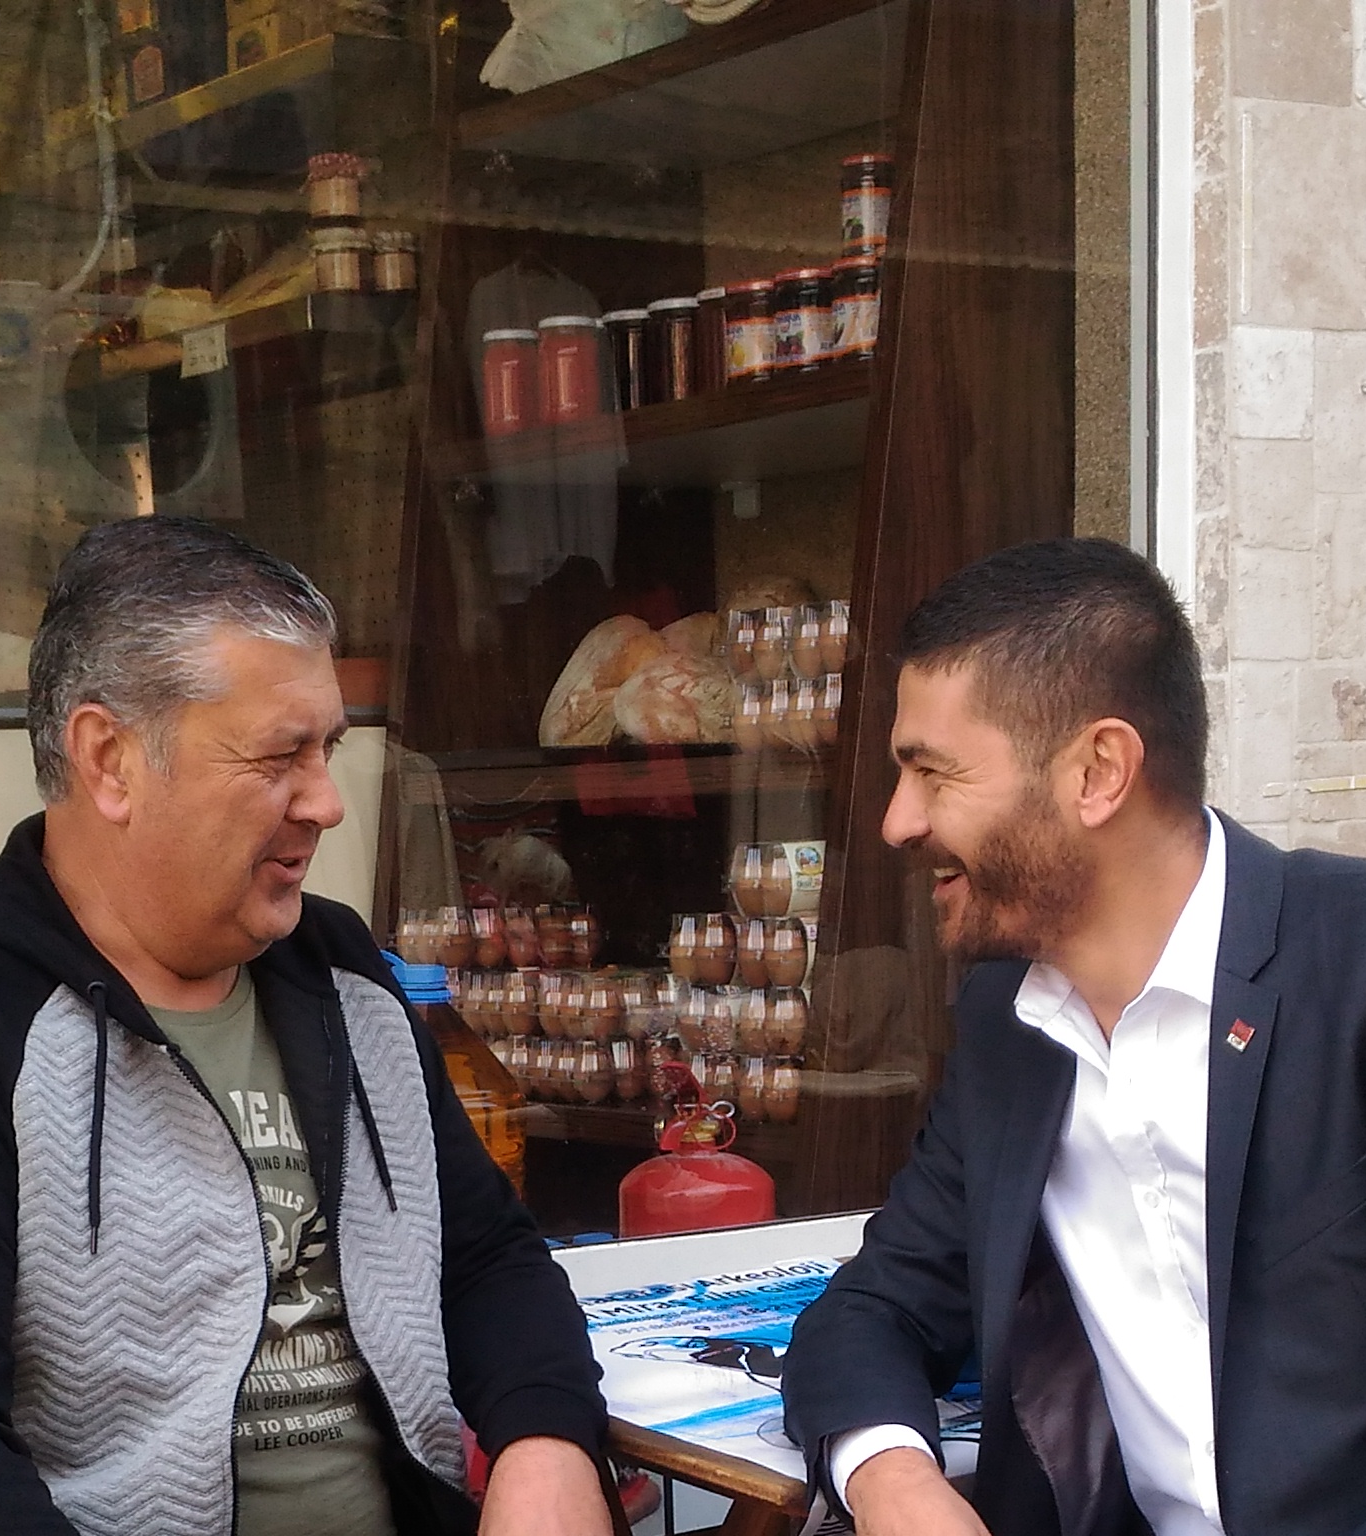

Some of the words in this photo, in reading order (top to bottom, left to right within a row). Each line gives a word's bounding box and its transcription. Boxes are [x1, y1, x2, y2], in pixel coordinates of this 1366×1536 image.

[285, 1156, 307, 1173] AND
[259, 1184, 305, 1212] SKILLS
[696, 1260, 830, 1288] Arkeoloji
[257, 1419, 281, 1435] TO
[284, 1415, 305, 1432] BE
[306, 1403, 359, 1429] DIFFERENT
[255, 1436, 282, 1451] LEE
[287, 1426, 344, 1448] COOPER
